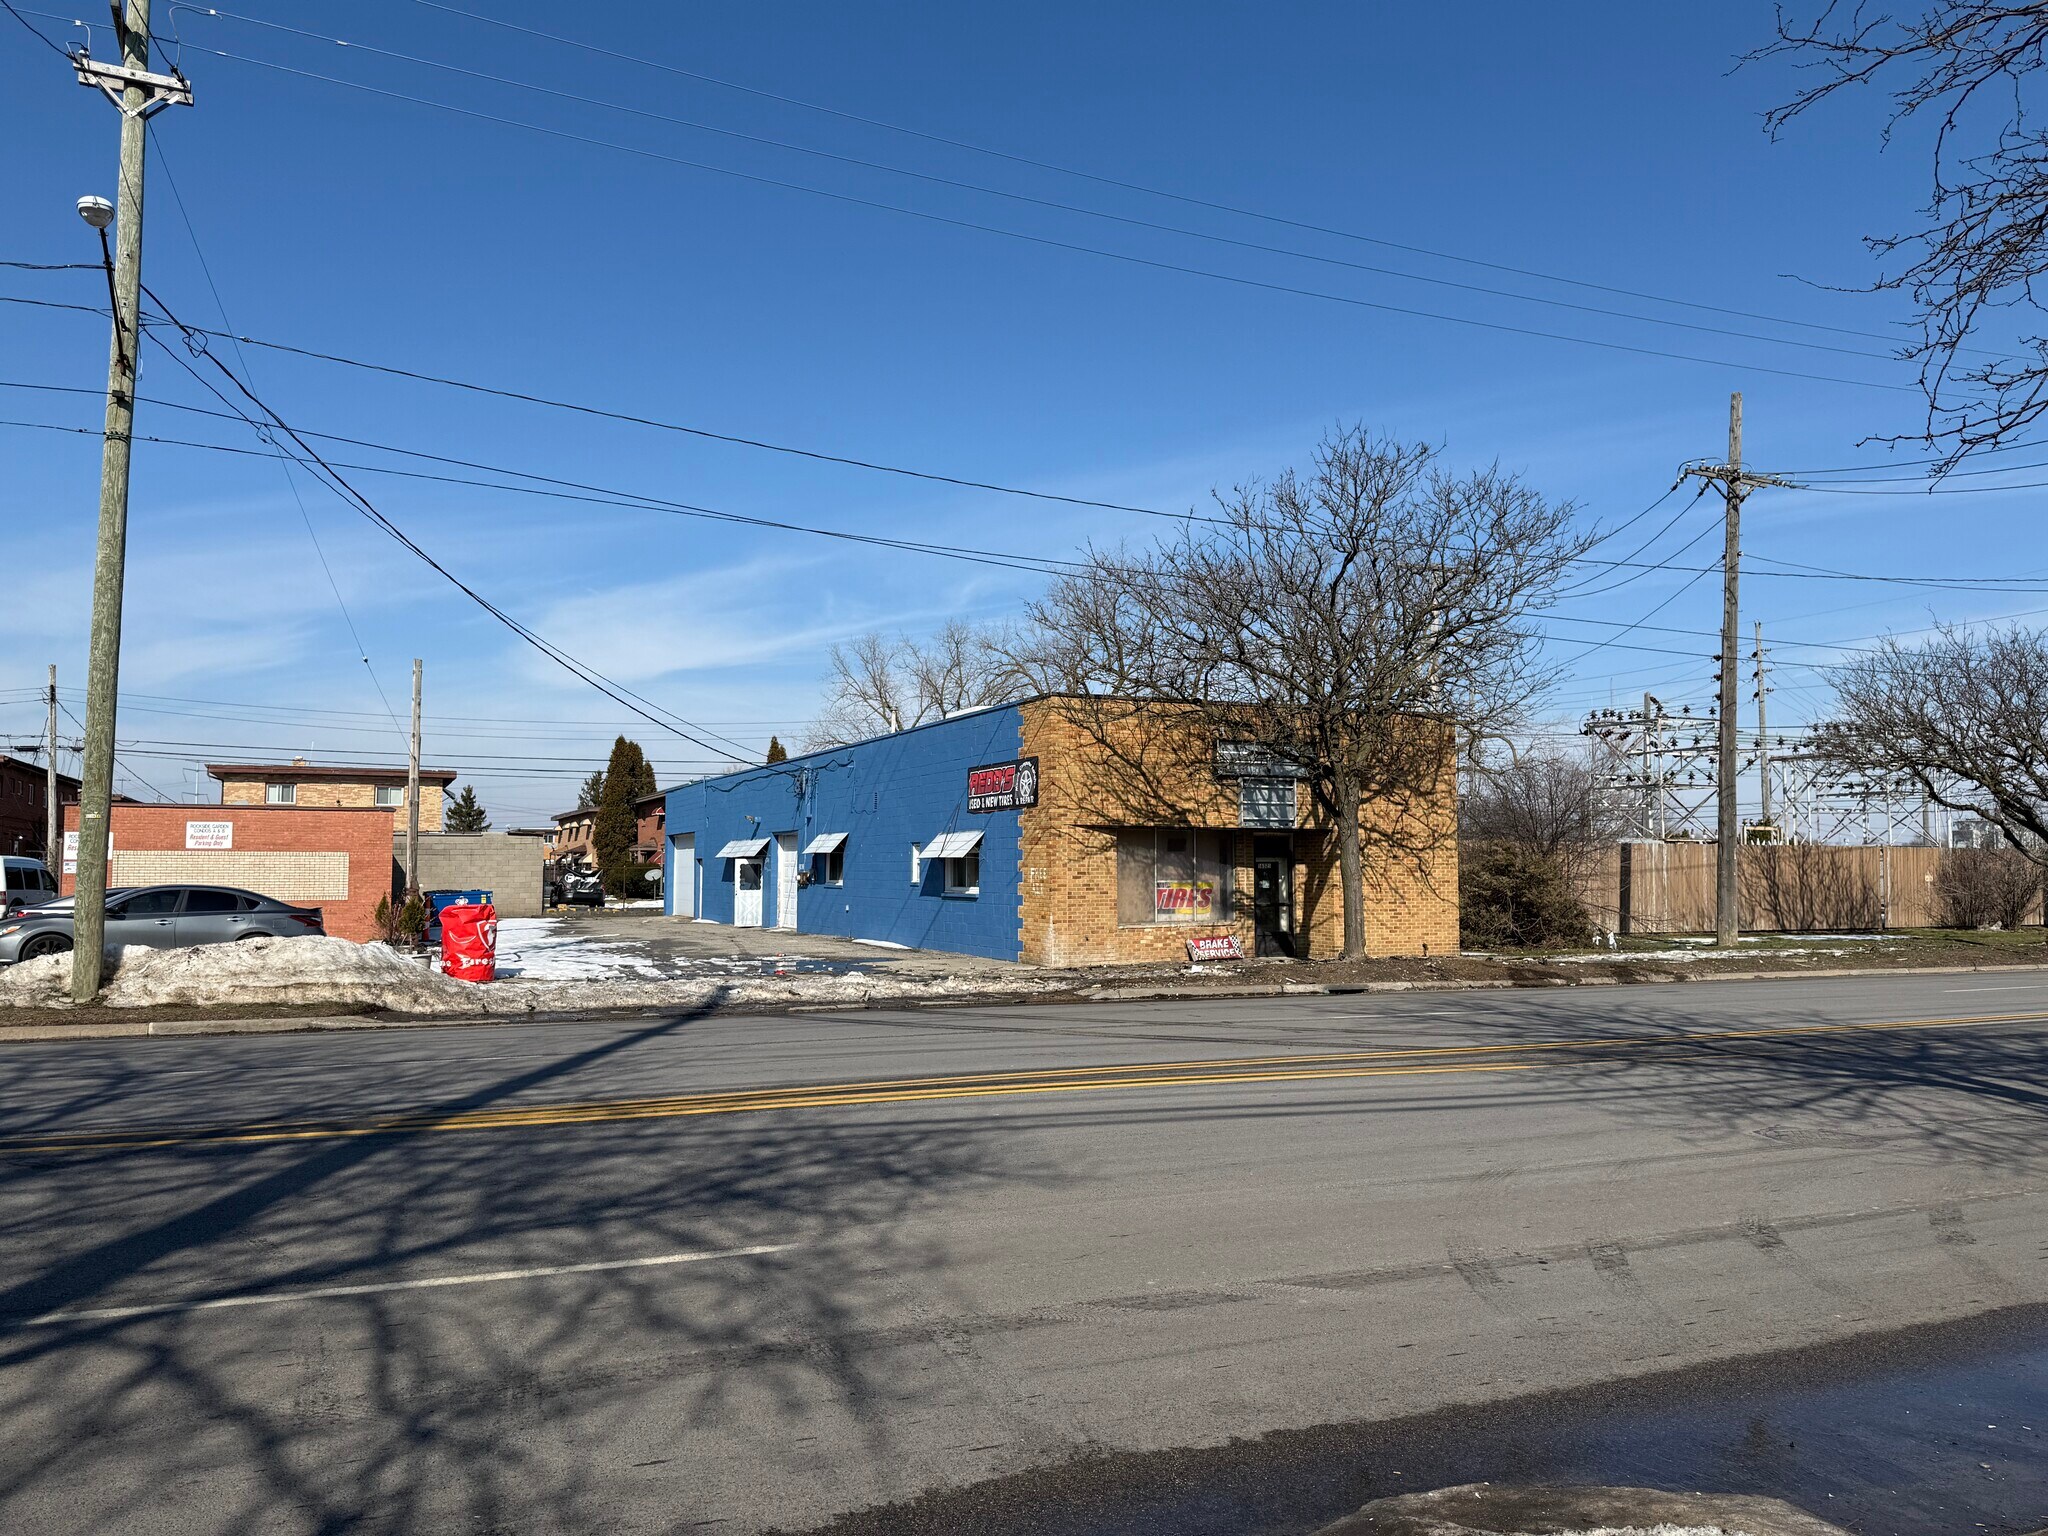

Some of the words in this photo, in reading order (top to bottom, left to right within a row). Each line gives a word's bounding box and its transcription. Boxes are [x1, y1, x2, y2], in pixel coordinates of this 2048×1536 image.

[969, 798, 980, 809] USED
[986, 796, 998, 808] NEW
[999, 794, 1013, 806] TIRES
[1157, 887, 1213, 909] TIRES
[1200, 938, 1229, 949] BRAKE
[1199, 948, 1236, 958] SERVICE
